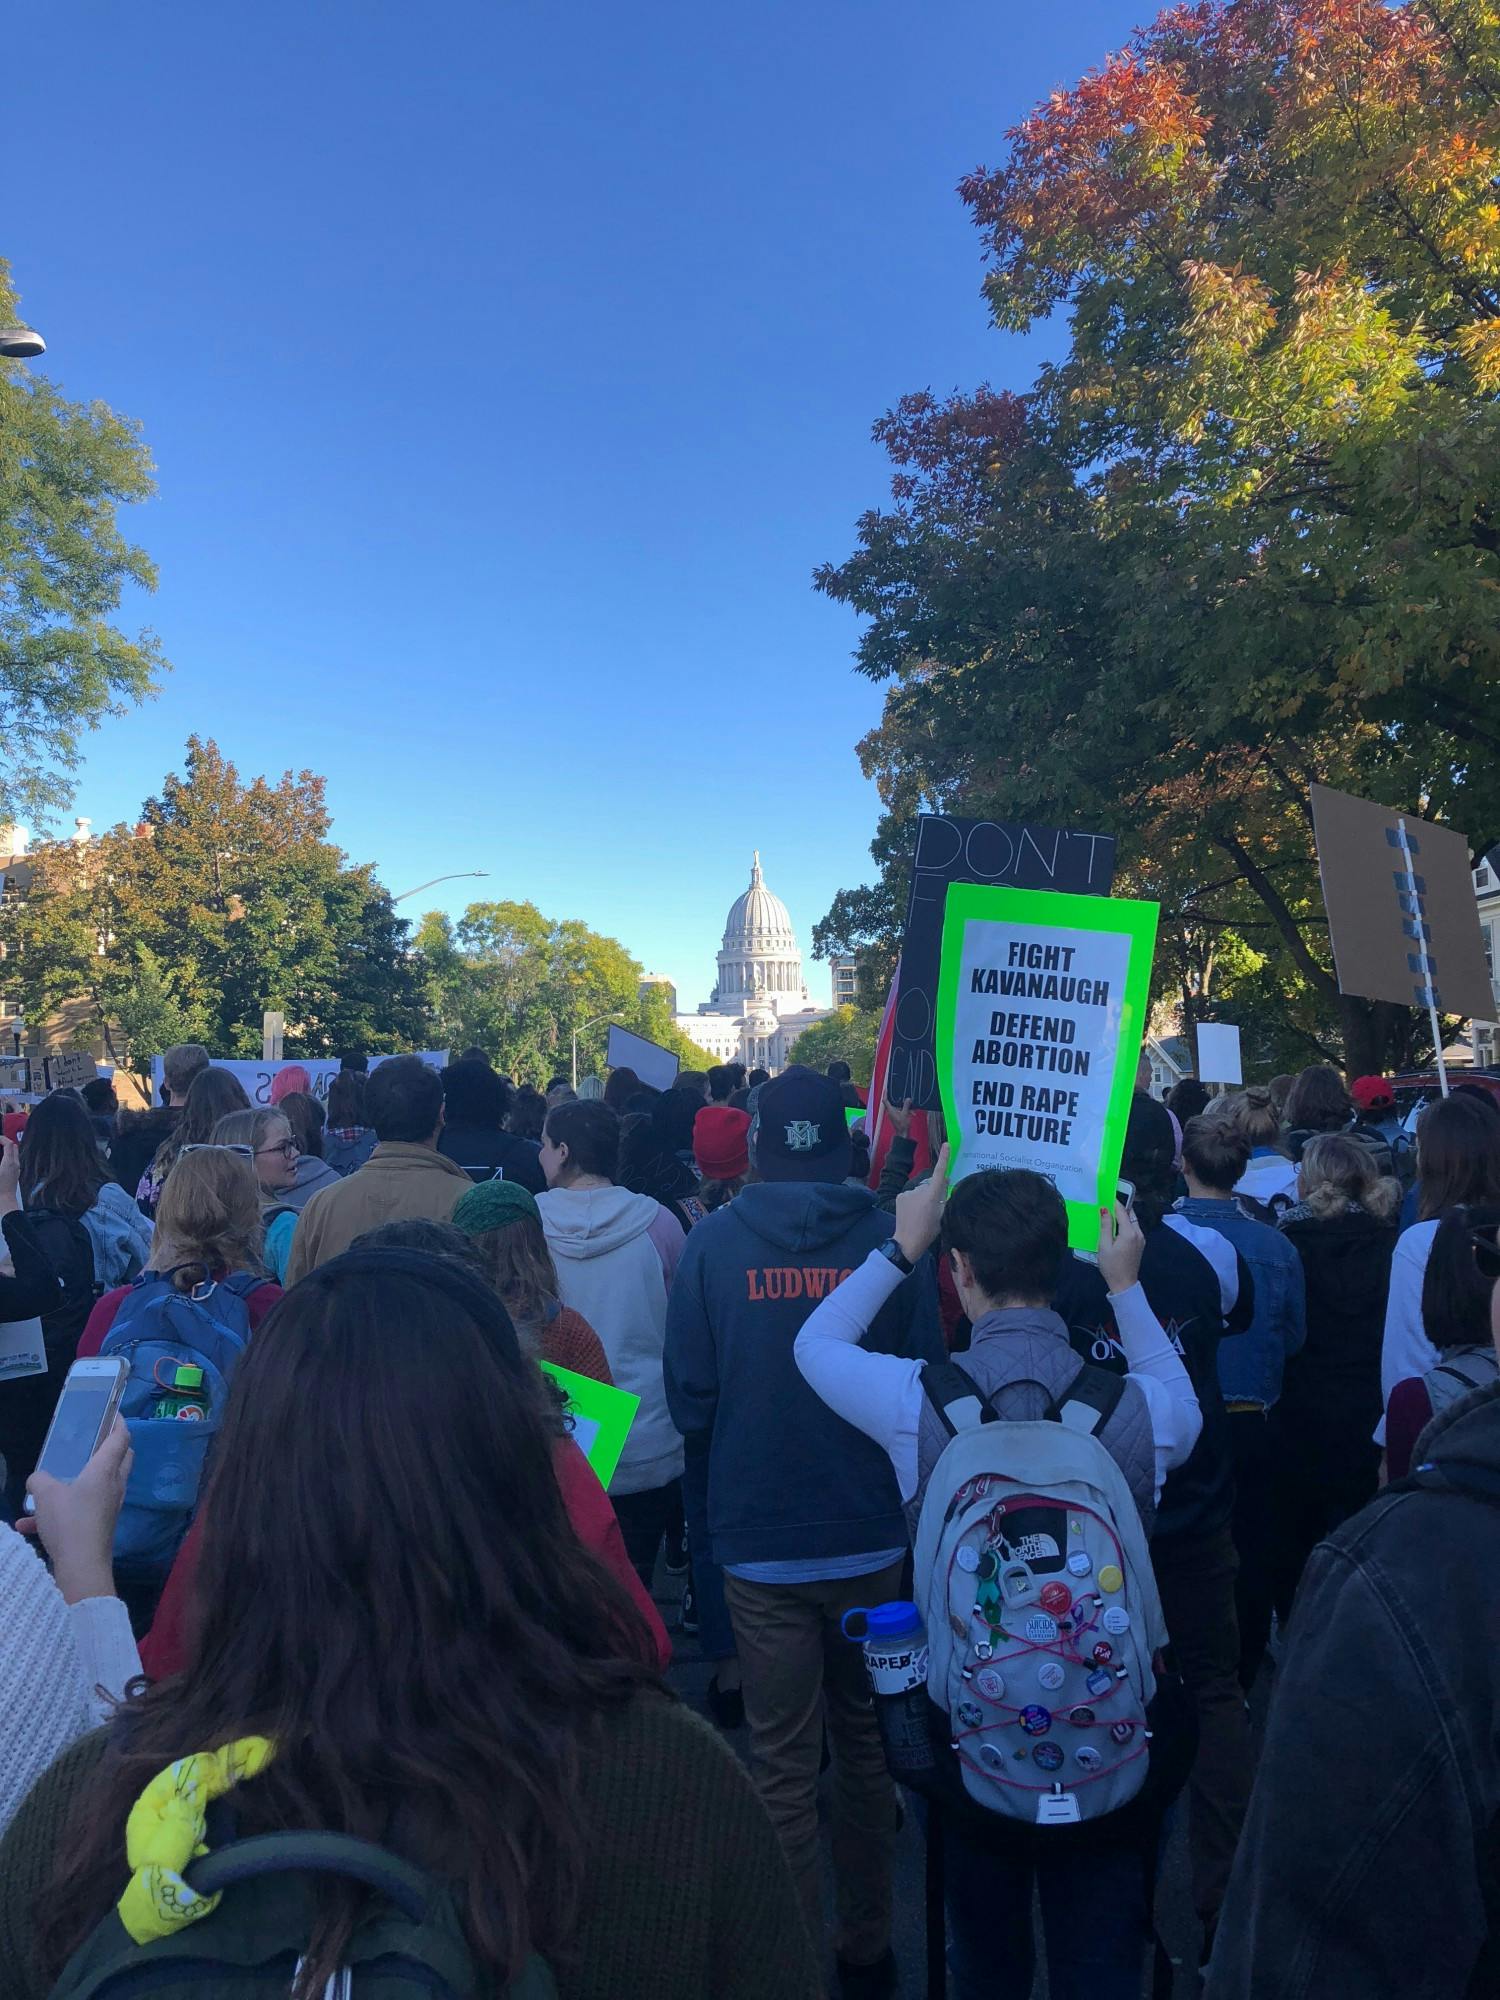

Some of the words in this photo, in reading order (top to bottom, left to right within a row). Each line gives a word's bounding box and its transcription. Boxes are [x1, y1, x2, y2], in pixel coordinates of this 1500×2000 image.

[915, 816, 1114, 884] DON'T
[1008, 942, 1076, 972] FIGHT
[971, 968, 1110, 1007] KAVANAUGH
[990, 1011, 1076, 1044] DEFEND
[971, 1039, 1090, 1076] ABORTION
[972, 1081, 1015, 1107] END
[1020, 1085, 1079, 1117] RAPE
[975, 1109, 1072, 1146] CULTURE
[1034, 1158, 1083, 1174] Organization
[1015, 1542, 1041, 1555] ORTH
[1020, 1534, 1040, 1545] THE
